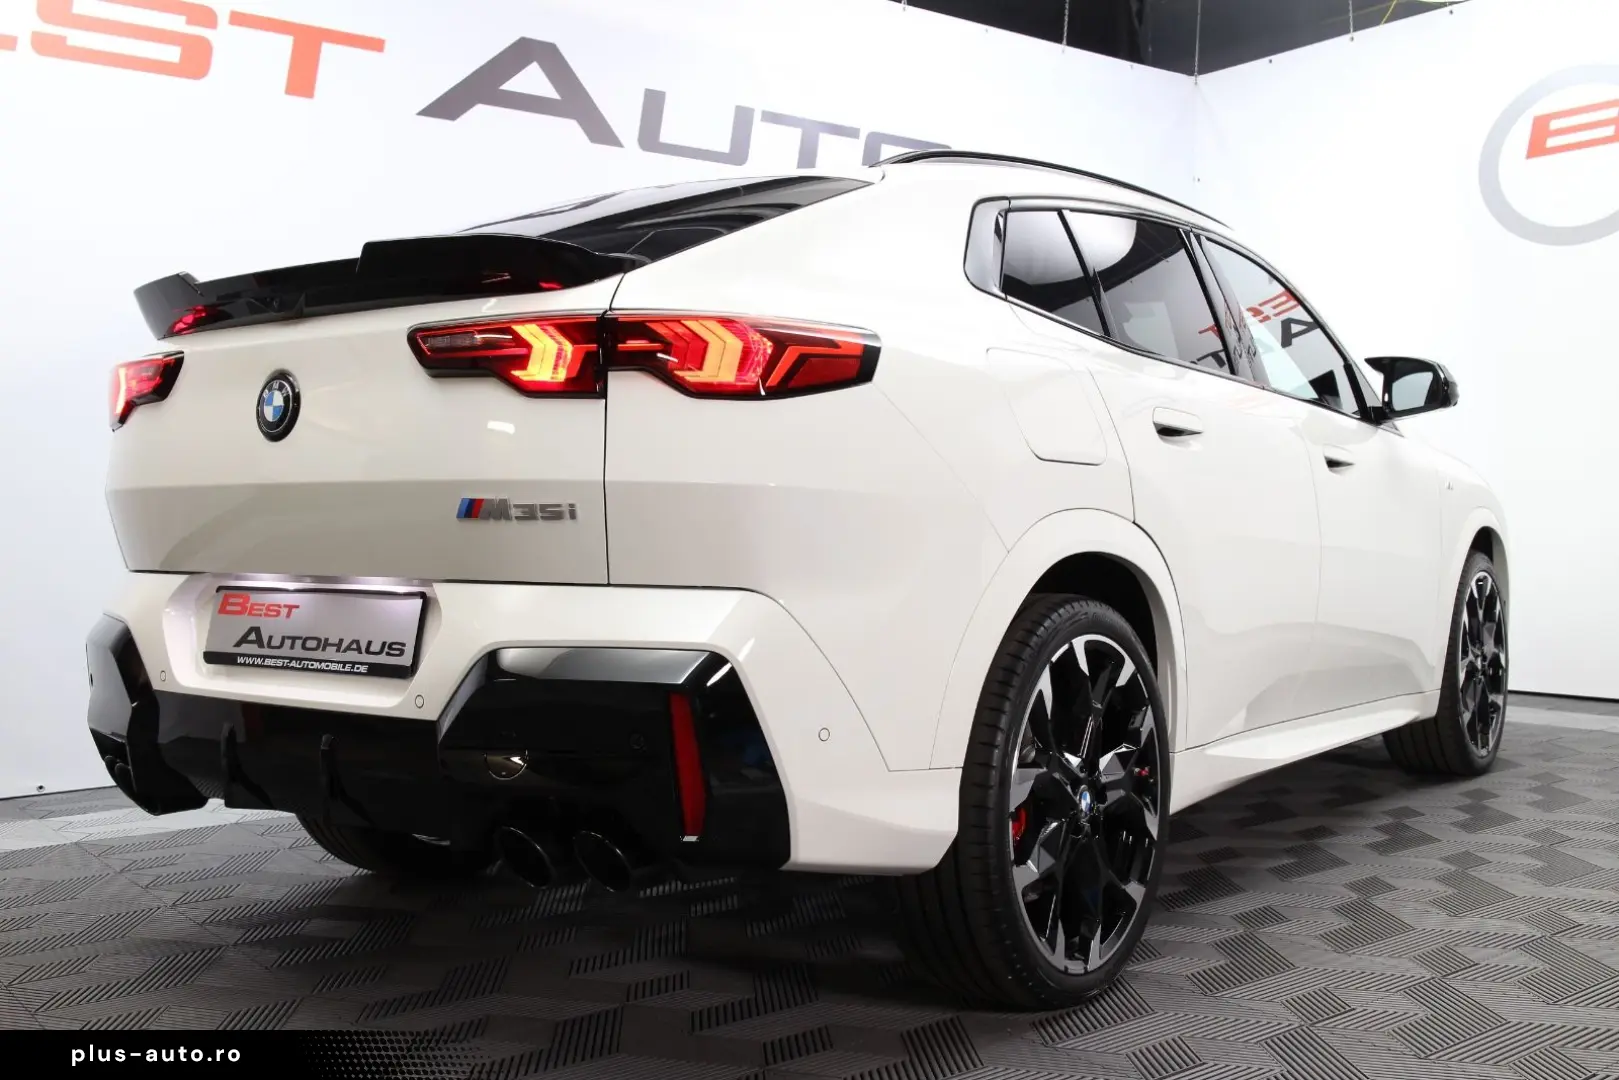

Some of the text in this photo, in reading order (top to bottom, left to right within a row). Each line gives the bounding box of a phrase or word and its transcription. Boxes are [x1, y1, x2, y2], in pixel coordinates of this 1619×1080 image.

[0, 0, 386, 98] ST
[457, 497, 577, 520] M35i
[218, 592, 300, 618] BEST
[233, 626, 406, 657] AUTOHAUS
[236, 656, 368, 673] WWW.BEST-AUTOMOBILE.DE
